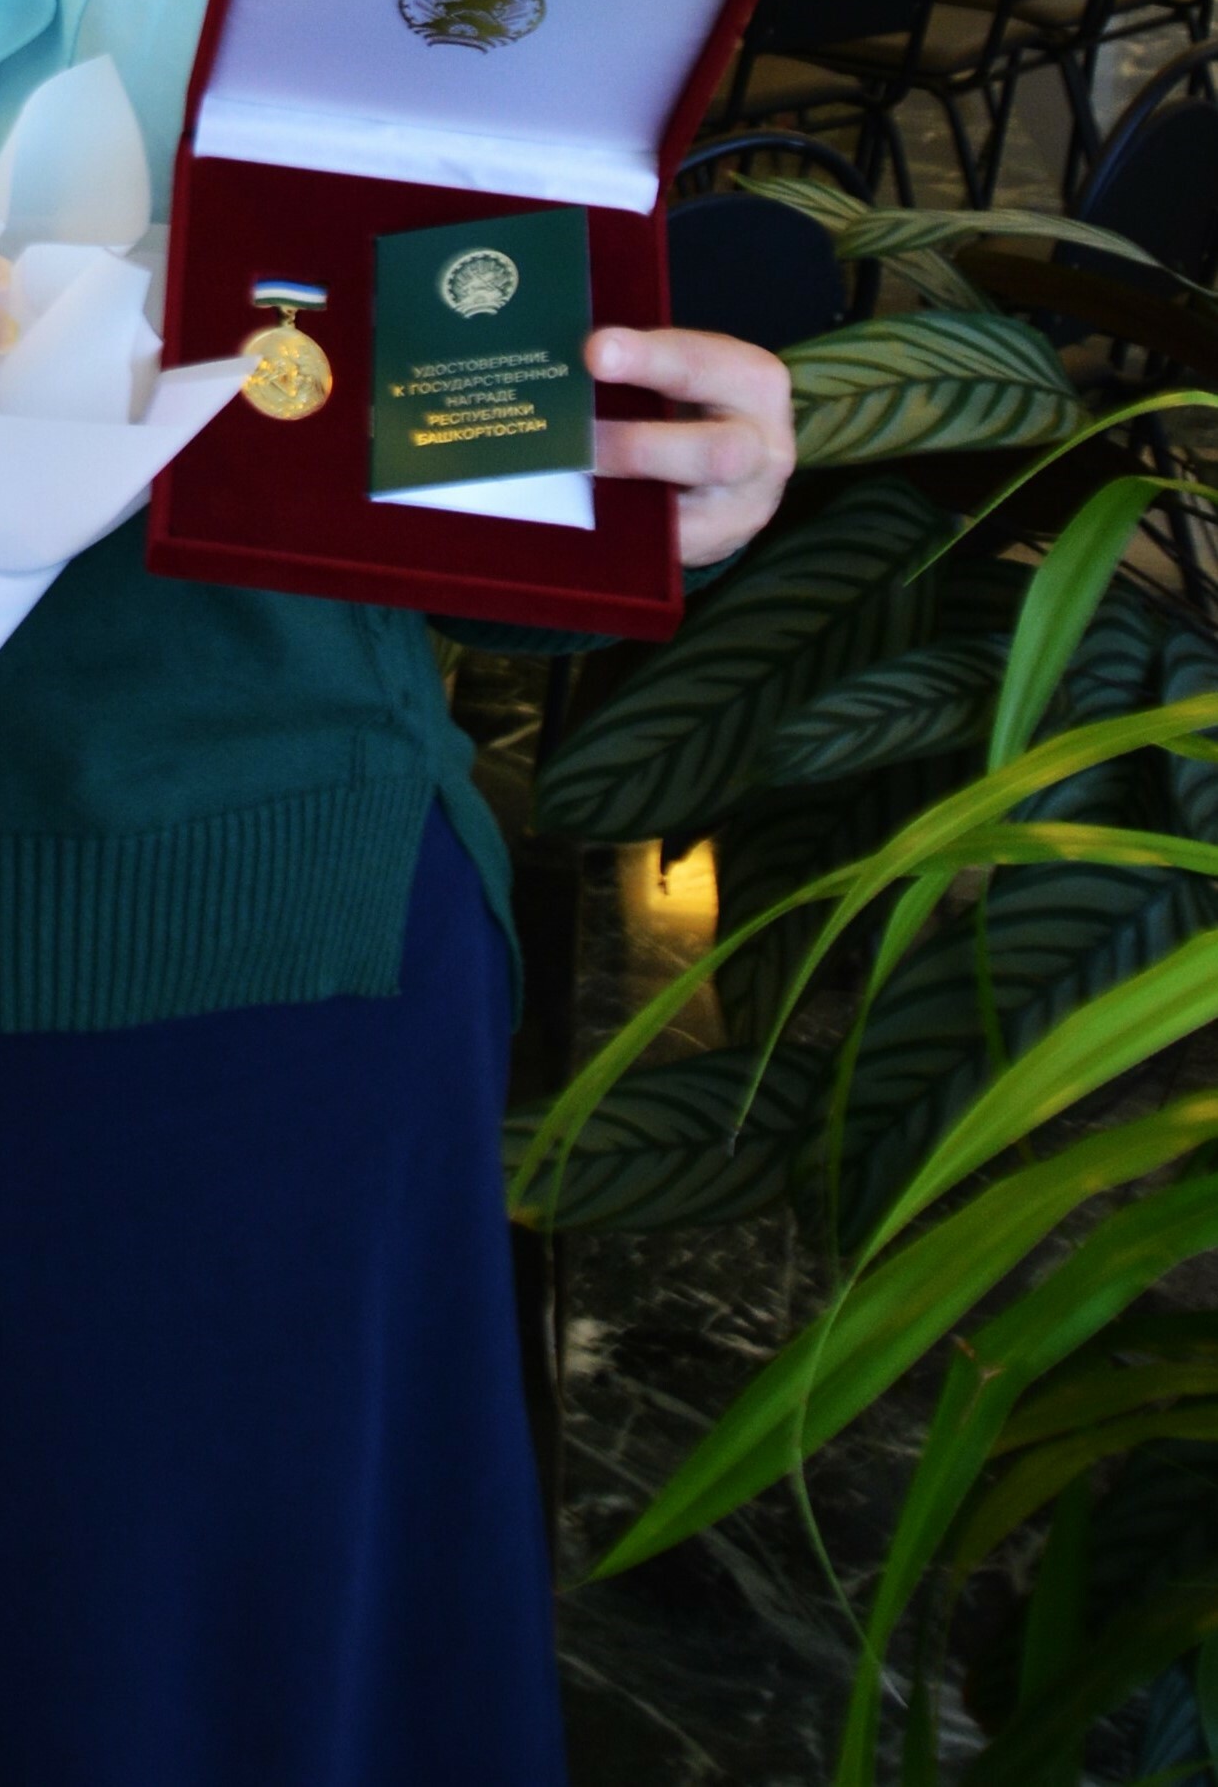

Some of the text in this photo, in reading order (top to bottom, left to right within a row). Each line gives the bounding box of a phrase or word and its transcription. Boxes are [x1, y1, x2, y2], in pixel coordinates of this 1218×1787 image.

[413, 351, 550, 379] УДОСТОВЕРЕНИЕ
[391, 363, 570, 398] К ГОСУДАРСТВЕННОЙ
[445, 389, 518, 407] НАГРАДЕ
[427, 404, 535, 427] РЕСПУБЛИКИ
[413, 419, 548, 446] БАШКОРТОСТАН
